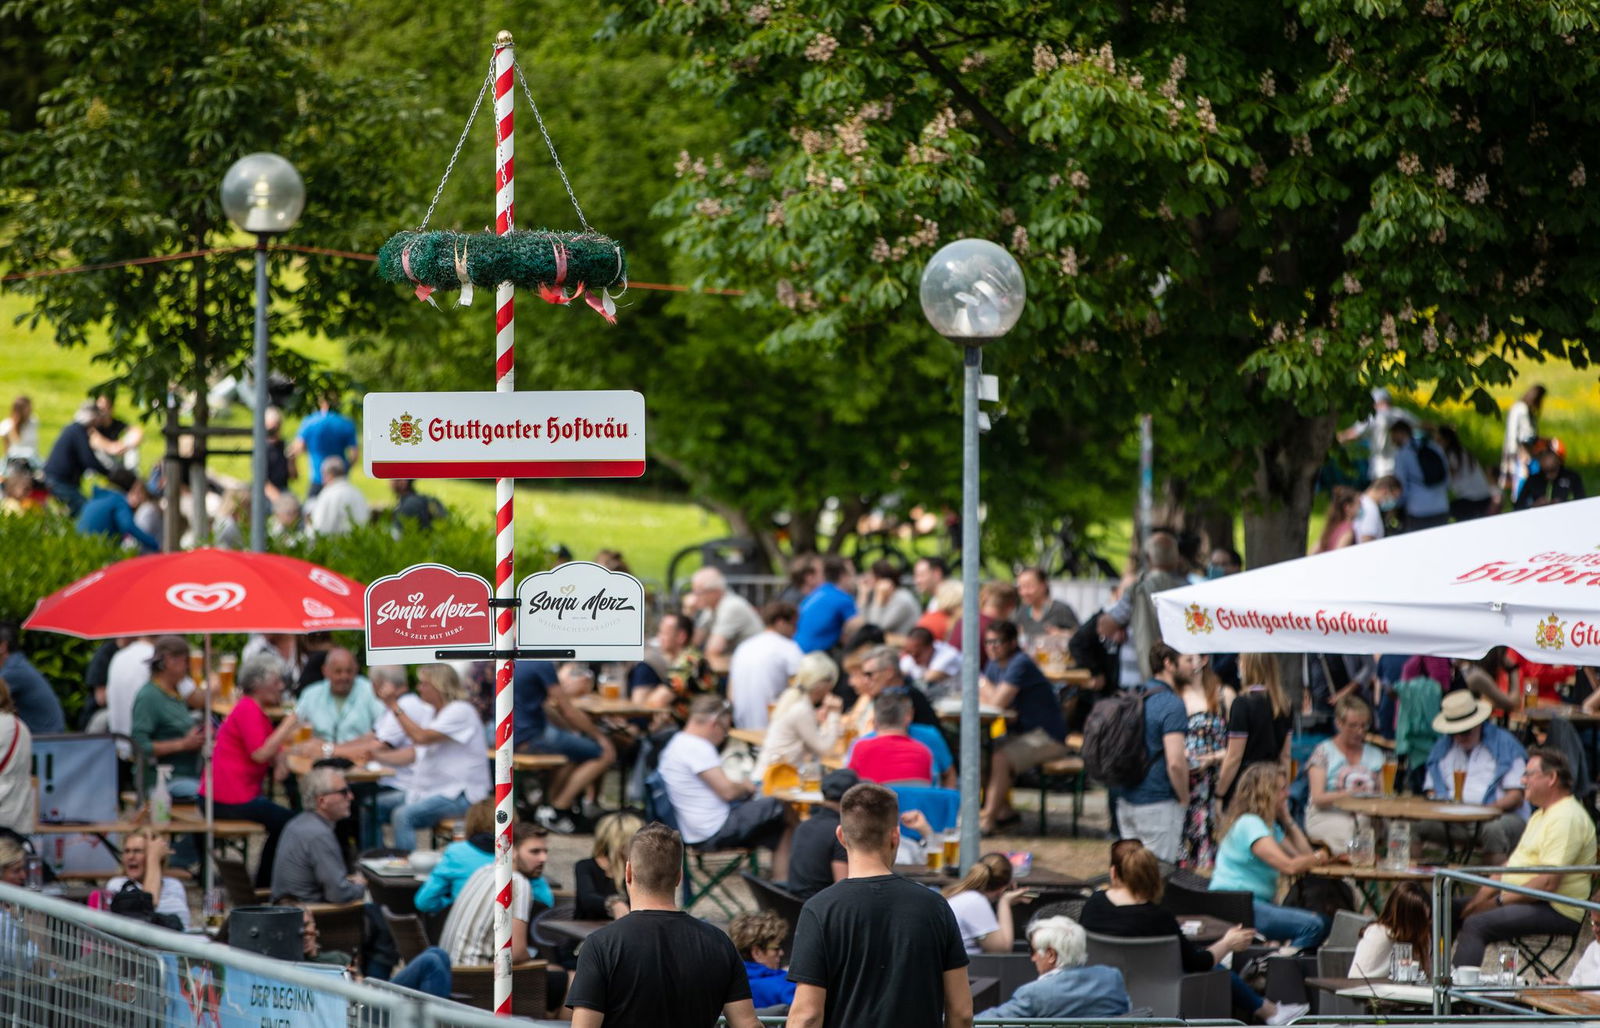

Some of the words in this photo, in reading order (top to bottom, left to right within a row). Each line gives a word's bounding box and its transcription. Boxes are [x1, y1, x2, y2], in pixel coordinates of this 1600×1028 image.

[428, 417, 543, 445] Stuttgarter
[547, 416, 629, 444] Hofbräu
[376, 598, 429, 629] Sonja
[430, 594, 486, 628] Merz
[528, 590, 580, 620] Sonja
[581, 587, 636, 620] Merz
[394, 627, 409, 637] DAS
[445, 625, 465, 637] HERZ
[1216, 607, 1312, 635] Stuttgarter
[1315, 608, 1389, 635] Hofbräu
[250, 984, 270, 1008] DER
[272, 986, 315, 1012] BEGINN
